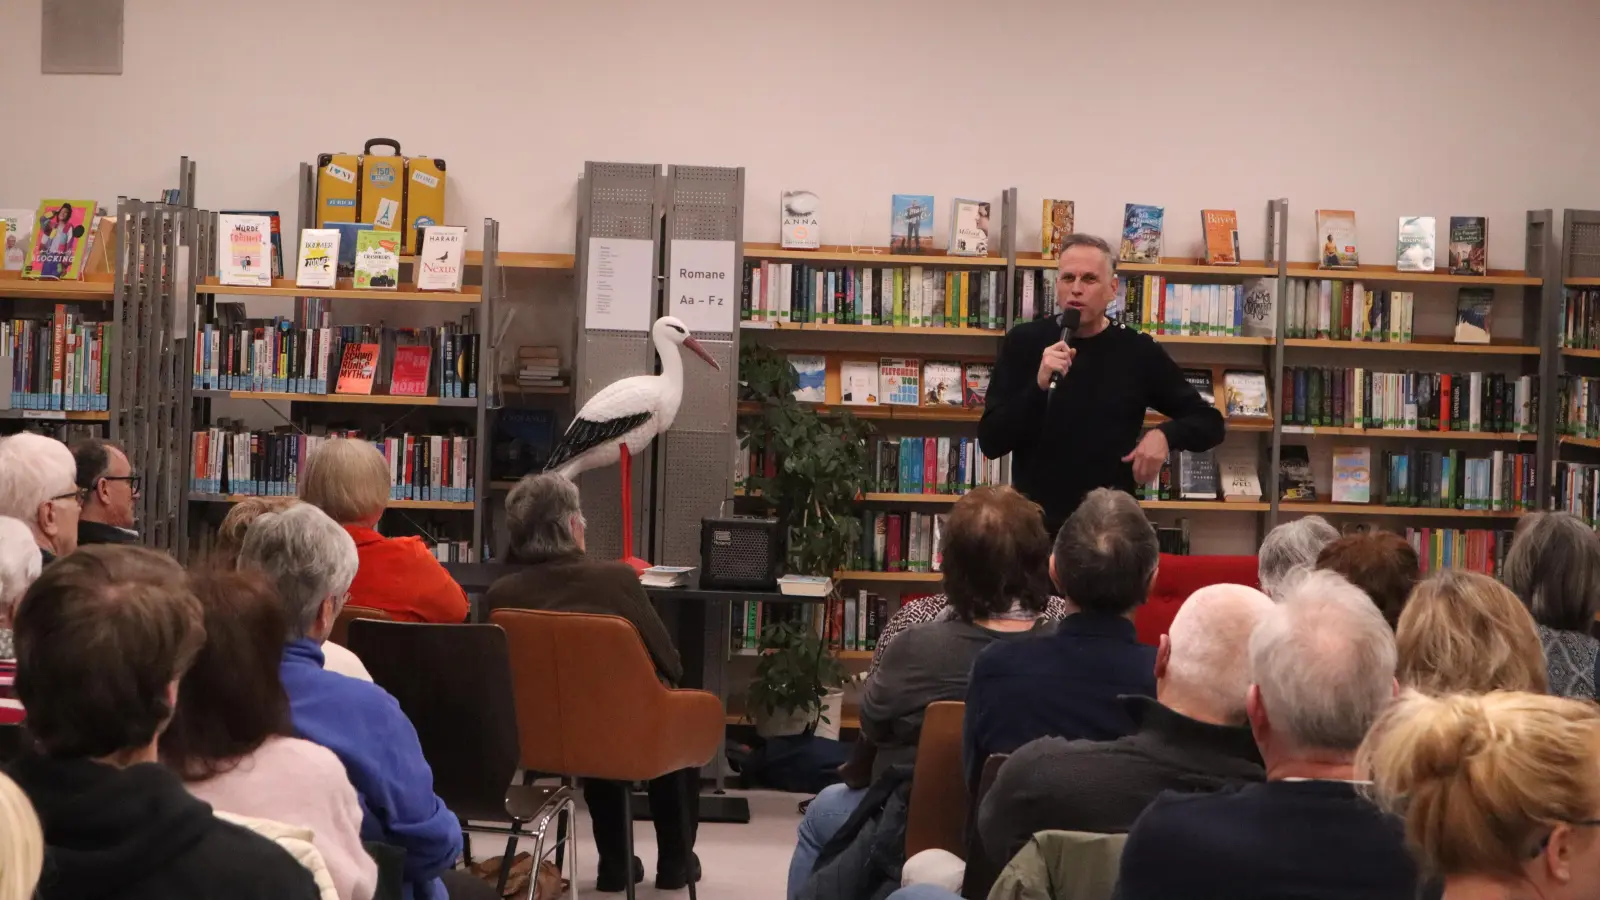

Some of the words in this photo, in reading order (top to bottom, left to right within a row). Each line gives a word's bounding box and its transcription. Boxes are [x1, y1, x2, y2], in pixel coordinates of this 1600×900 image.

[31, 255, 76, 263] BLOCKING
[679, 268, 725, 280] Romane
[679, 295, 694, 305] Aa
[346, 343, 361, 352] VER
[901, 377, 918, 385] VON
